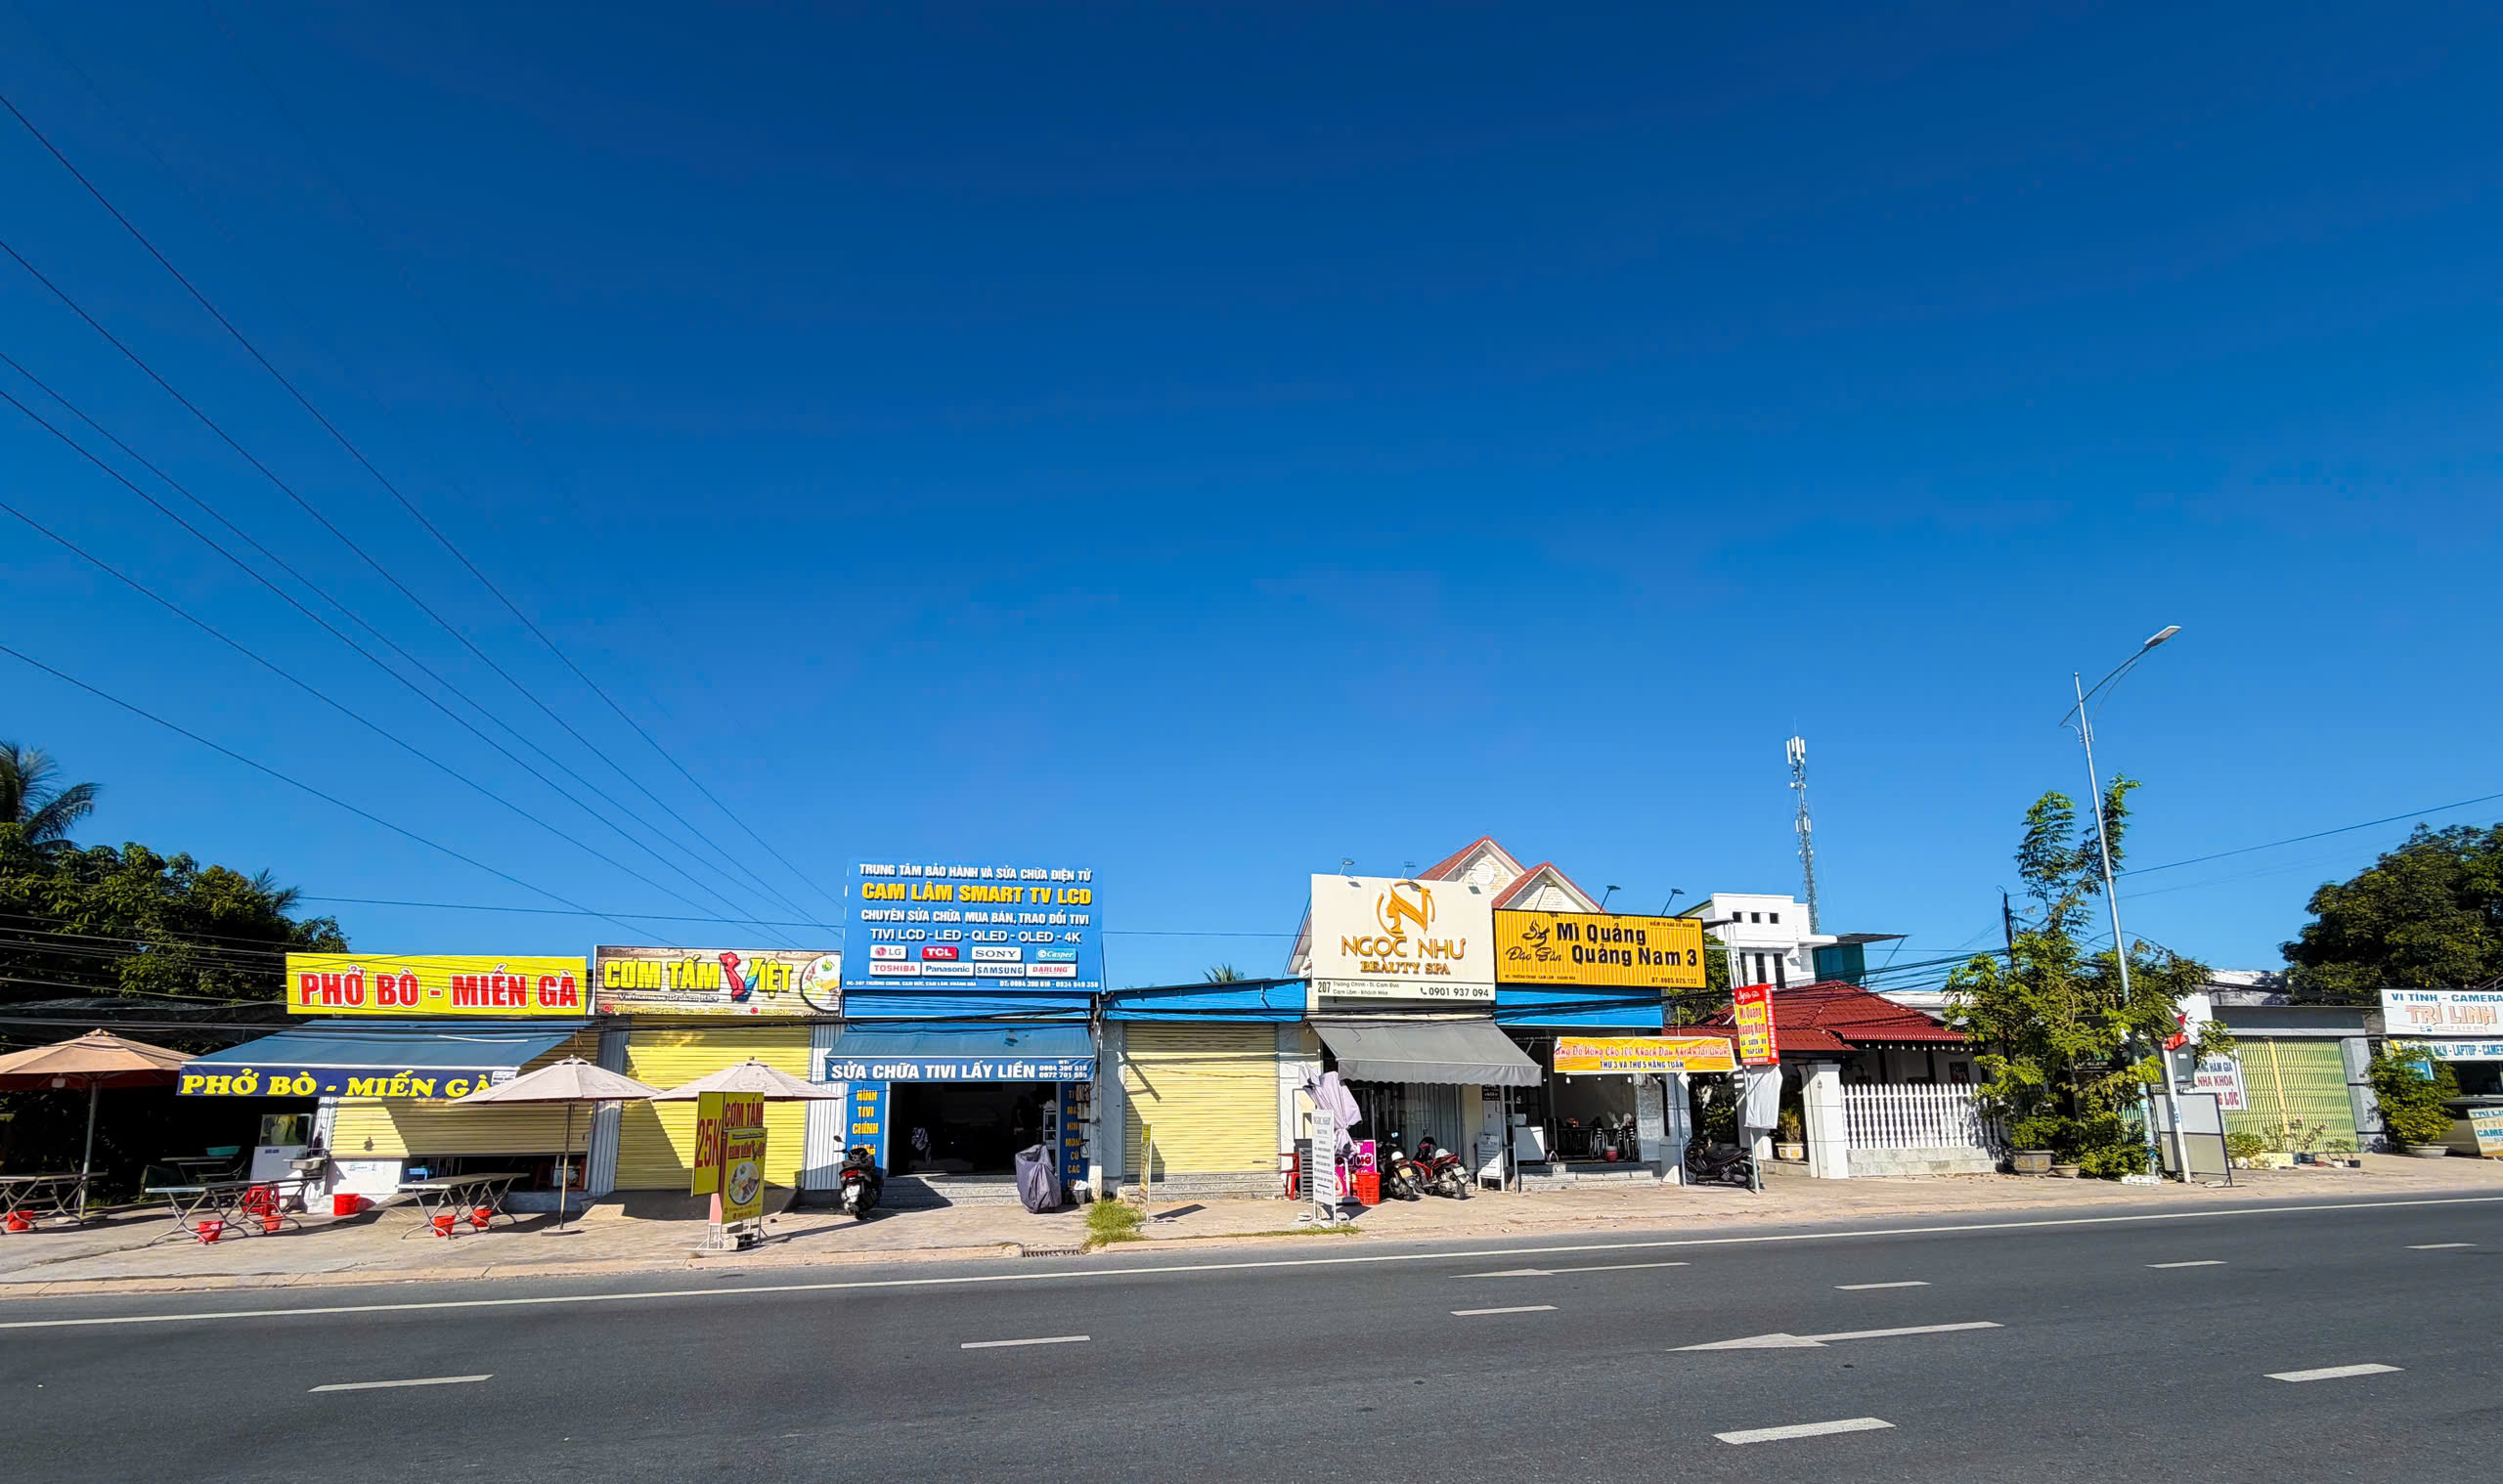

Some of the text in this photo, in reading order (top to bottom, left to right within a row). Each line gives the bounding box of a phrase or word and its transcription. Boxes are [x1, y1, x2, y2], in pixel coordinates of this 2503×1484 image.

[859, 862, 1092, 883] TRUNG TÂM BẢO HÀNH VÀ SỬA CHỮA ĐIỆN TỬ
[861, 881, 1092, 905] CAM LÂM SMART TV LCD
[861, 907, 1089, 925] CHUYÊN SỬA CHỮA MUA BÁN, TRAO ĐỔI TIVI
[869, 928, 1081, 943] TIVI LCD LED QLED OLED 4K
[1557, 922, 1647, 946] Mì Quảng
[927, 948, 952, 957] TCL
[1046, 950, 1074, 959] Casper
[1341, 936, 1466, 961] NGỌC NHƯ
[1571, 943, 1697, 968] Quảng Nam 3
[603, 958, 661, 990] CƠM
[668, 954, 721, 991] TẤM
[977, 966, 1024, 975] SAMSUNG
[1360, 960, 1451, 976] BEAUTY SPA
[298, 964, 367, 1007] PHỞ
[374, 969, 419, 1007] BÒ
[451, 963, 528, 1008] MIẾN
[538, 970, 579, 1008] GÀ
[1318, 982, 1331, 993] 207
[1428, 987, 1489, 997] 0901 937 094
[2392, 991, 2503, 1003] VI TÍNH CAMERA
[2448, 1006, 2498, 1026] LINH
[1620, 1046, 1633, 1057] 100
[2452, 1045, 2477, 1056] LAPTOP
[831, 1060, 1035, 1079] SỬA CHỮA TIVI LẤY LIỀN
[1613, 1060, 1618, 1069] 3
[1643, 1060, 1647, 1069] 5
[1648, 1059, 1666, 1069] HÀNG
[180, 1069, 259, 1096] PHỞ
[267, 1071, 318, 1096] BÒ
[345, 1069, 437, 1098] MIẾN
[444, 1074, 491, 1098] GÀ
[2197, 1074, 2234, 1087] NHA KHOA
[725, 1095, 764, 1127] CƠM TẤM
[857, 1106, 875, 1118] TIVI
[852, 1121, 879, 1135] CHÍNH
[696, 1118, 722, 1168] 25K
